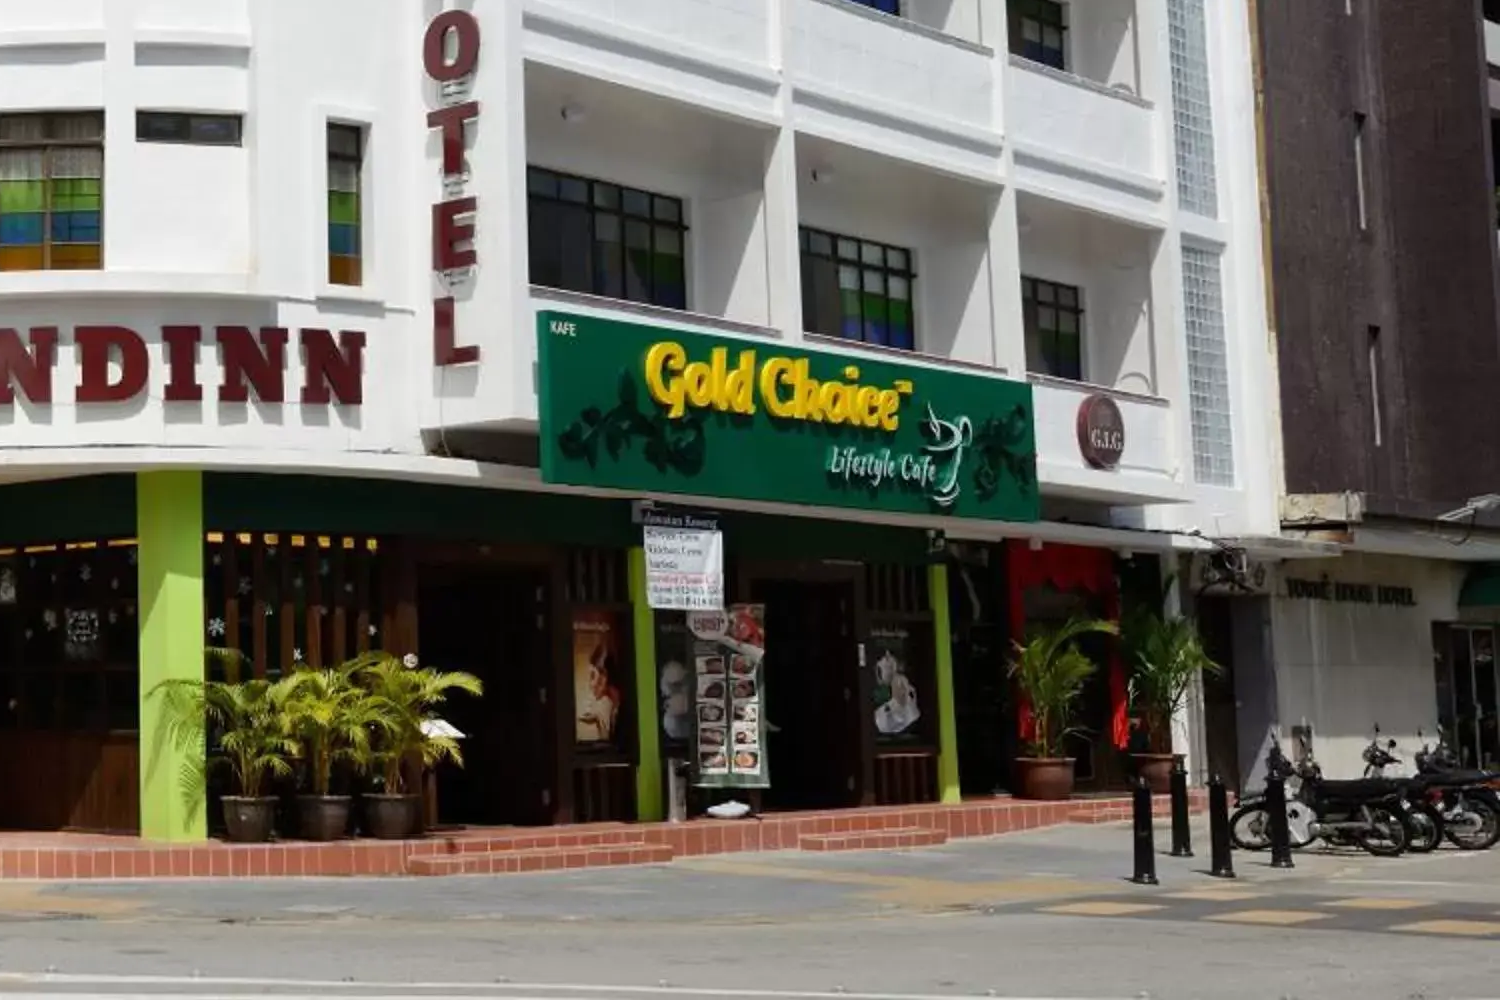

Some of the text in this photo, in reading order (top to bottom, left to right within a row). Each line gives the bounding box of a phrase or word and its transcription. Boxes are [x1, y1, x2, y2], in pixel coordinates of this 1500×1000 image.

[550, 320, 577, 337] KAFE
[644, 341, 899, 430] Gold Choice
[831, 446, 938, 486] Lifestyle Cafe
